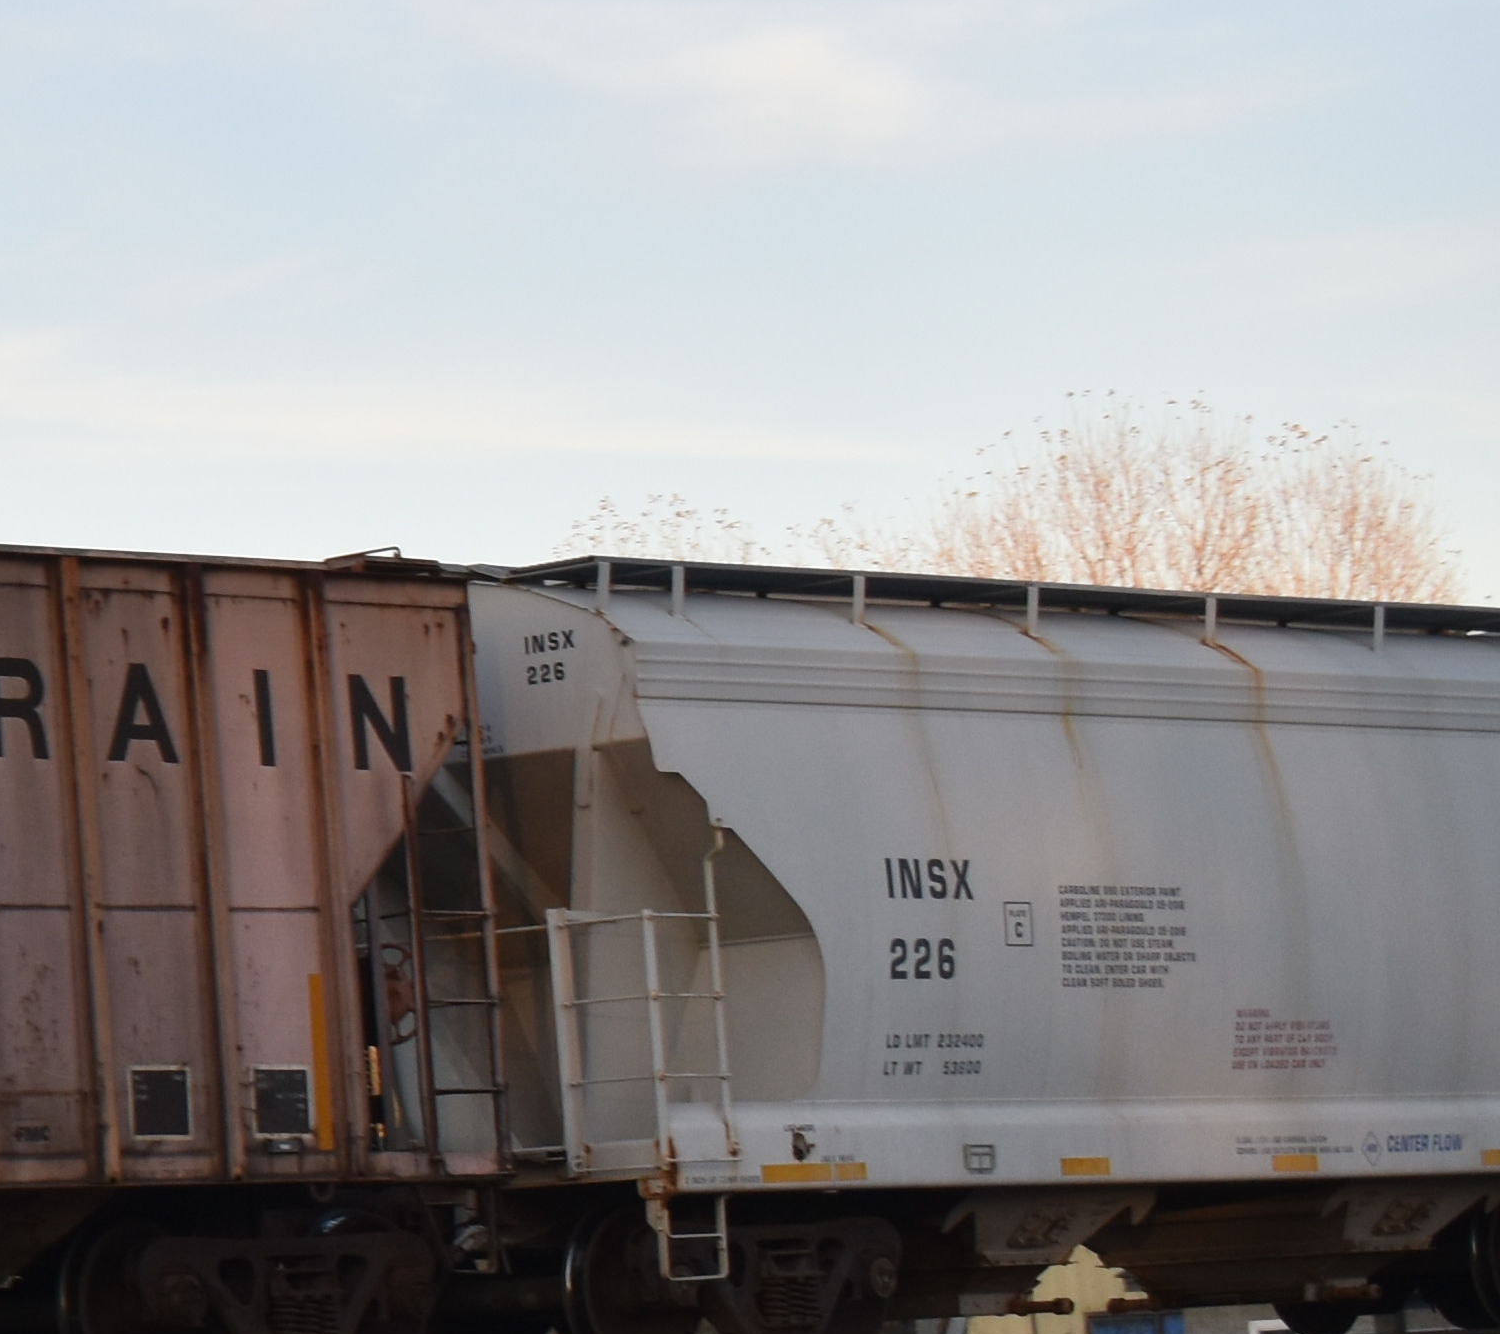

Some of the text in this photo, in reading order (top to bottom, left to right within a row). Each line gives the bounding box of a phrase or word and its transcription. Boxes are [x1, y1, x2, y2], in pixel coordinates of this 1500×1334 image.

[523, 629, 575, 655] INSX
[526, 661, 565, 685] 226
[884, 857, 974, 900] INSX
[1014, 921, 1023, 939] C
[889, 937, 956, 980] 226
[885, 1033, 901, 1049] LD
[905, 1033, 931, 1049] LMT
[883, 1060, 899, 1076] LT
[902, 1060, 923, 1076] WT
[1386, 1134, 1429, 1153] CENTER
[1432, 1134, 1463, 1152] FLOW
